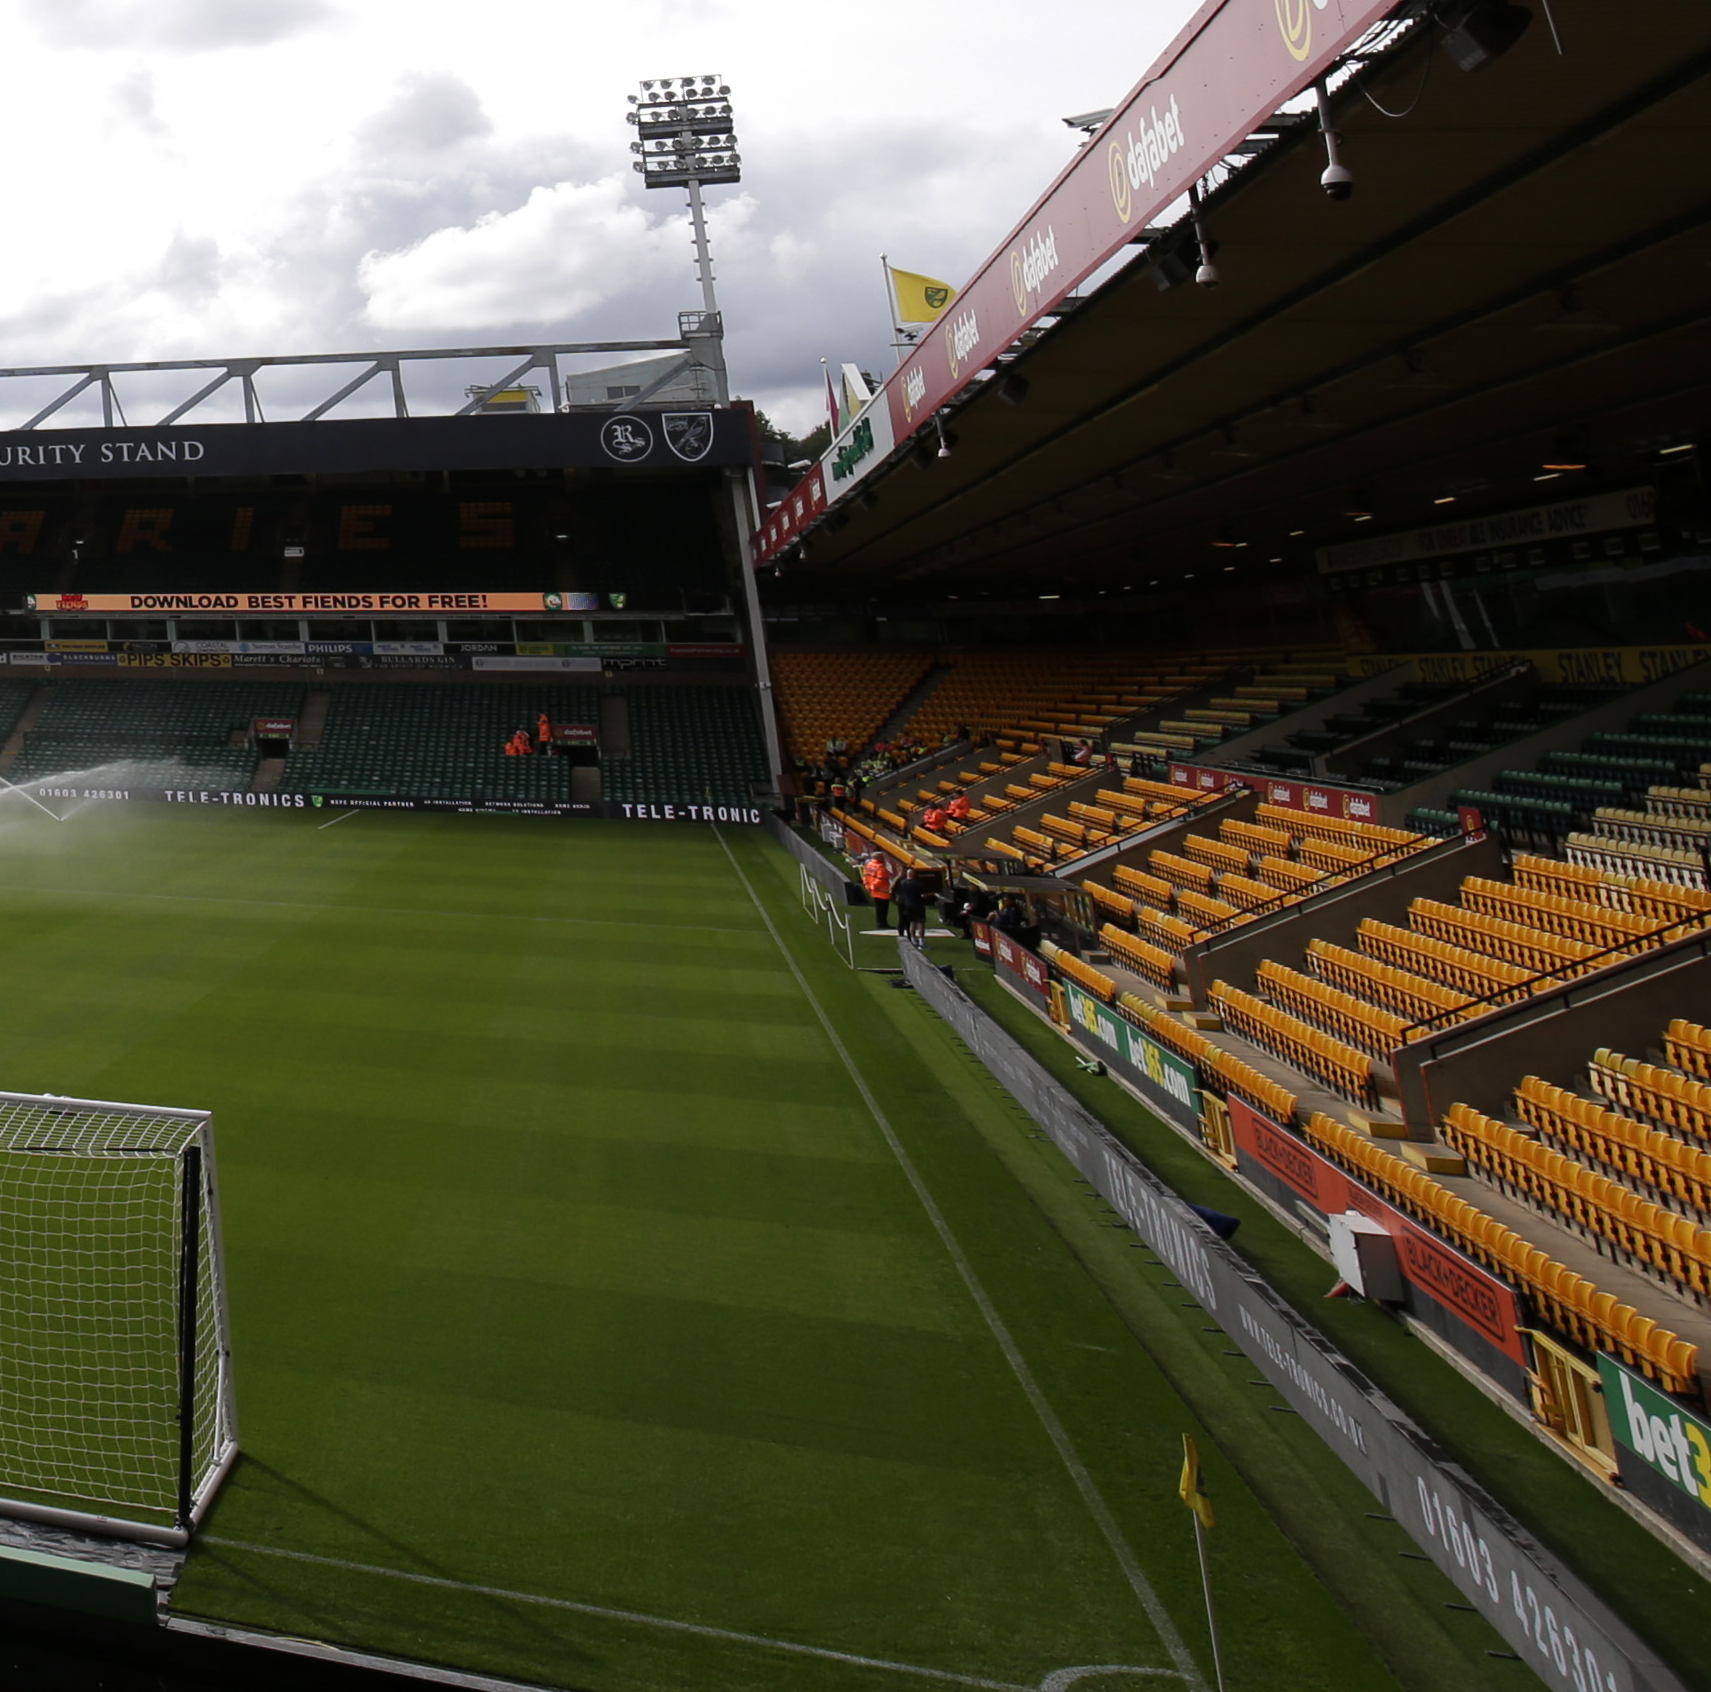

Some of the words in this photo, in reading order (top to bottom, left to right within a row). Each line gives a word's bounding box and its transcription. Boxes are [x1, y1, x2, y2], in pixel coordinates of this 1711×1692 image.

[1127, 94, 1185, 191] dafabet
[1022, 225, 1059, 293] dafabet
[953, 309, 980, 362] dafabet
[101, 440, 205, 463] STAND
[1547, 503, 1588, 534] ADVICE
[130, 595, 239, 608] DOWNLOAD
[247, 596, 296, 608] BEST
[301, 596, 373, 608] FIENDS
[379, 595, 421, 608] FOR
[428, 594, 488, 608] FREE!
[278, 654, 321, 664] Chariots
[308, 644, 353, 653] PHILIPS
[460, 644, 498, 652] JORDAN
[127, 654, 165, 666] PIPS
[170, 654, 222, 666] SKIPS
[1419, 656, 1466, 683] STANLEY
[1558, 651, 1623, 684] STANLEY
[39, 788, 77, 798] 01603
[84, 789, 130, 800] 426301
[165, 790, 305, 808] TELE-TRONICS
[383, 800, 415, 808] PARTNER
[1125, 1024, 1192, 1108] bet365.com
[1416, 1475, 1500, 1605] 01603
